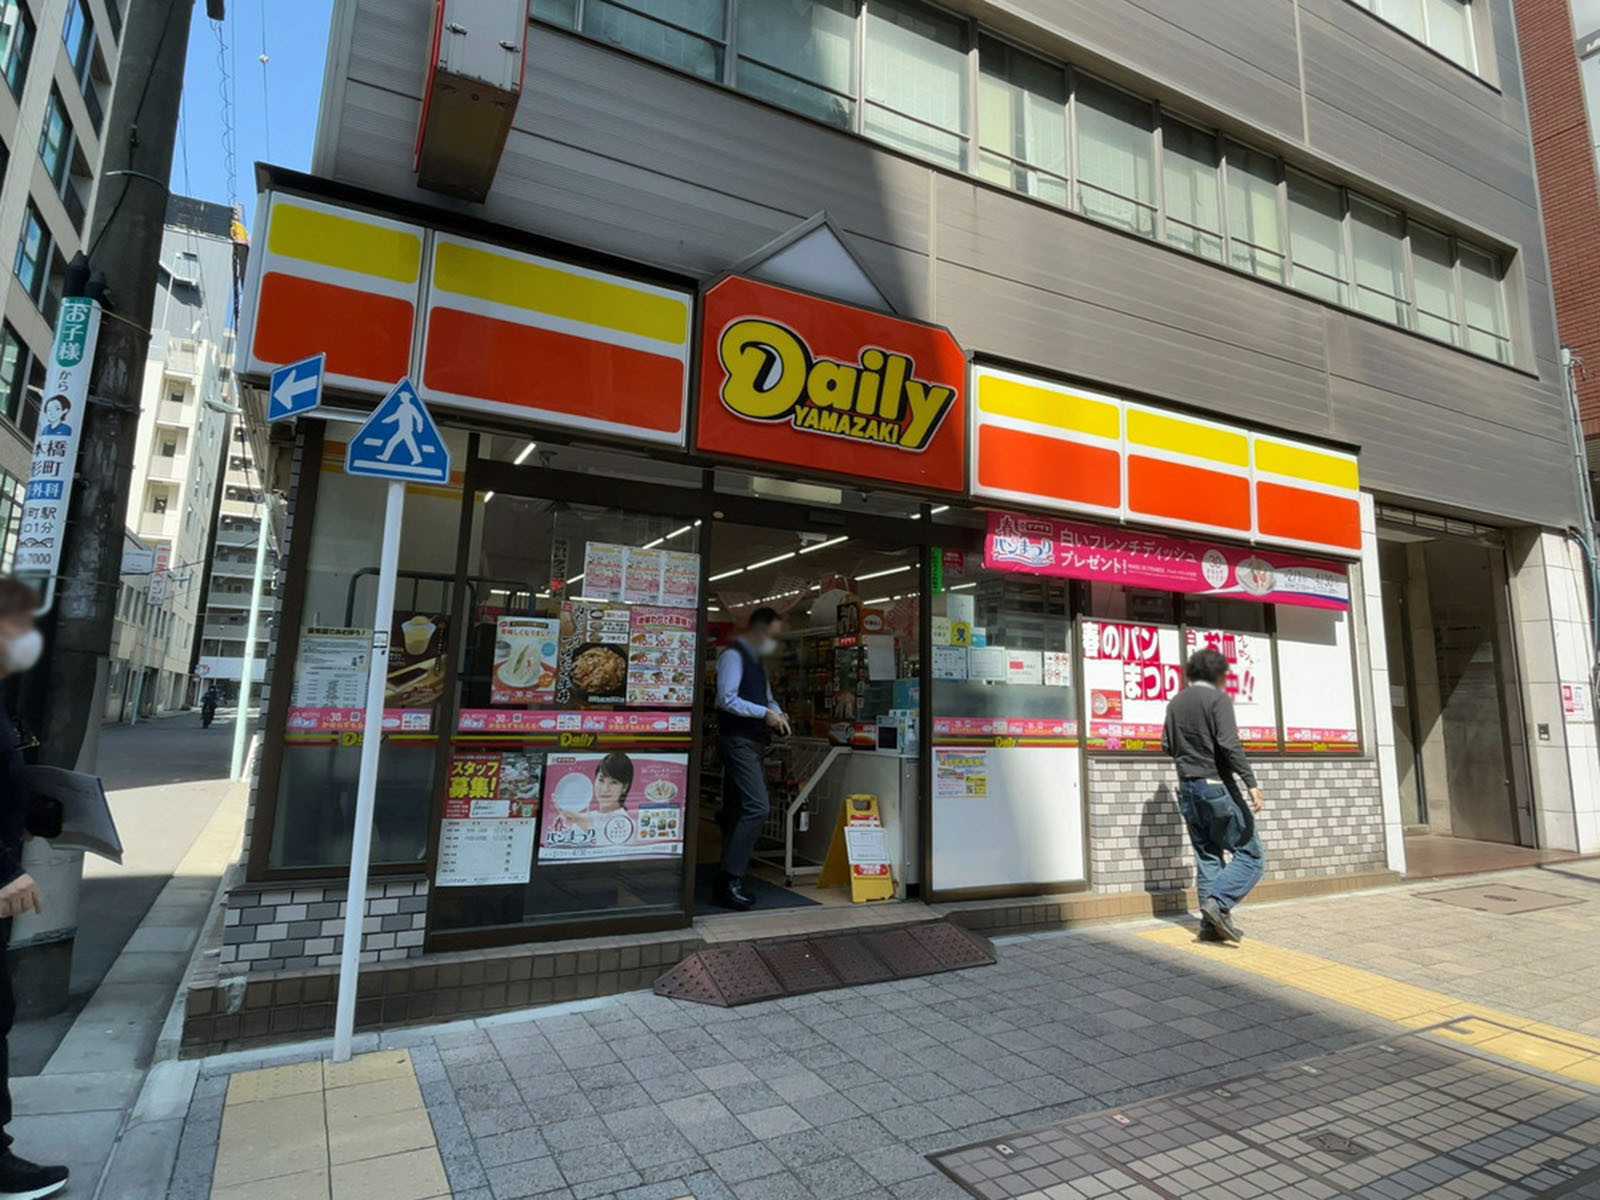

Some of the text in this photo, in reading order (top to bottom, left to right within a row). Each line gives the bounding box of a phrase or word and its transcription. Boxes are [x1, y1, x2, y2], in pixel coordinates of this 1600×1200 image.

[59, 303, 88, 360] お子様
[58, 370, 71, 391] から
[718, 317, 956, 451] Daily
[794, 404, 902, 445] YAMAZAKI
[994, 537, 1052, 556] パンまつり
[1060, 528, 1198, 563] 白いフレンチディッシュ
[1060, 551, 1127, 575] プレゼント!
[1082, 622, 1158, 660] 春のパン
[1124, 663, 1180, 701] まつり
[560, 732, 595, 748] Daily
[451, 761, 499, 776] スタッフ
[449, 776, 497, 799] 募集!
